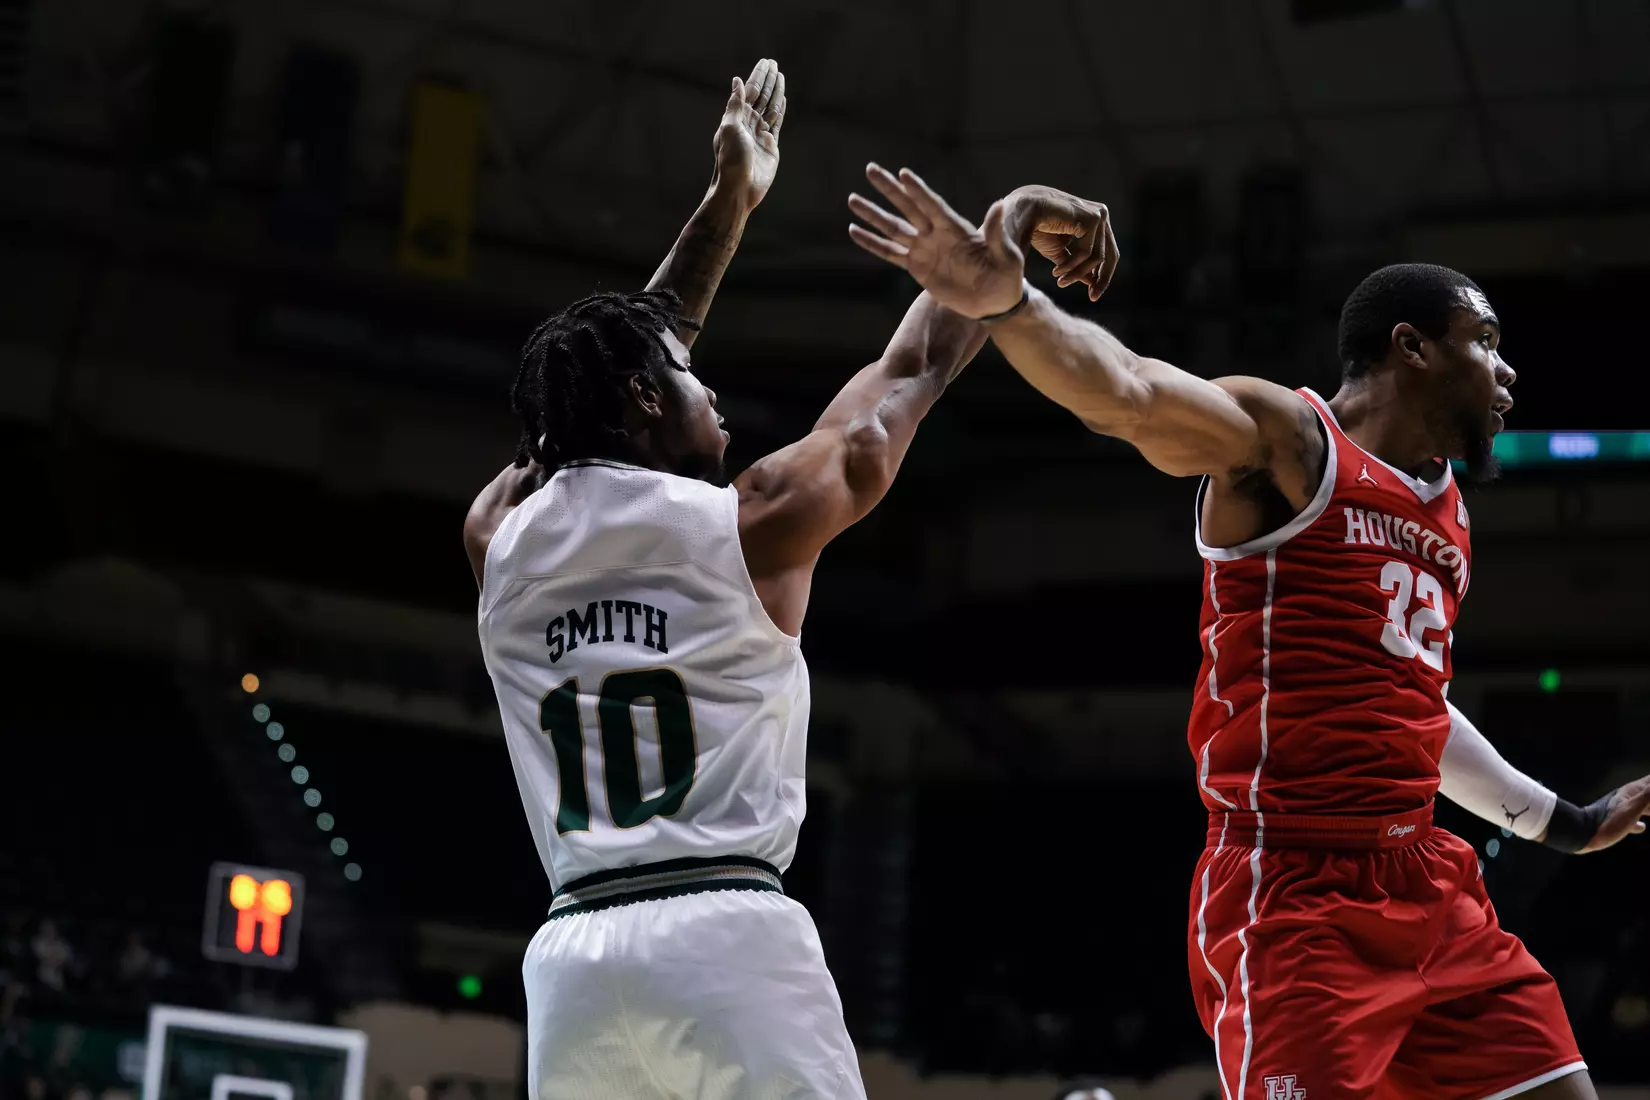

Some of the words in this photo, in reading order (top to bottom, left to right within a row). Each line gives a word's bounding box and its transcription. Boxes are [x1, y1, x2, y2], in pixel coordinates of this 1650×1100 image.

[1343, 507, 1467, 594] HOUSTON
[546, 600, 668, 664] SMITH
[1380, 561, 1447, 672] 32
[538, 666, 699, 838] 10
